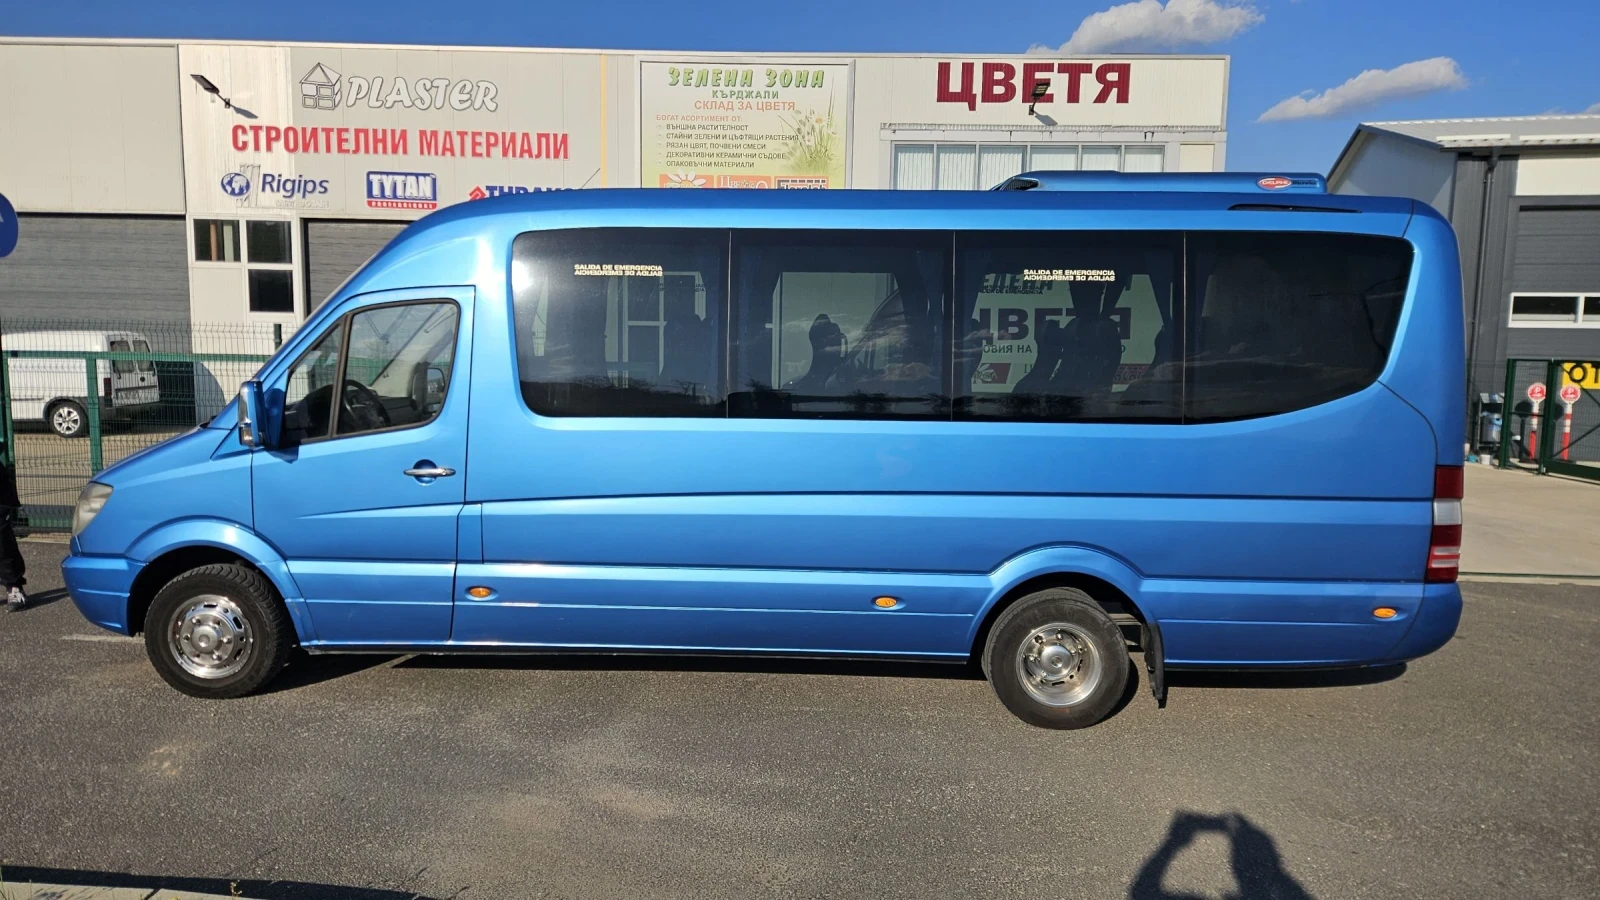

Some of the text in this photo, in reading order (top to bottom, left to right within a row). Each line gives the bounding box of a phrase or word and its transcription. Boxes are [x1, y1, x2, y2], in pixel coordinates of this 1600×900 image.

[668, 66, 825, 89] ЗЕЛЕНА ЗОНА
[936, 61, 1131, 111] ЦВЕТЯ
[346, 76, 498, 113] PLASTER
[694, 100, 796, 112] СКЛАД ЗА ЦВЕТЯ
[712, 90, 779, 100] КЪРДЖАЛИ
[231, 124, 569, 160] СТРОИТЕЛНИ МАТЕРИАЛИ
[758, 152, 786, 160] СЪДОВЕ
[261, 173, 329, 199] Rigips
[369, 174, 433, 200] TYTAN
